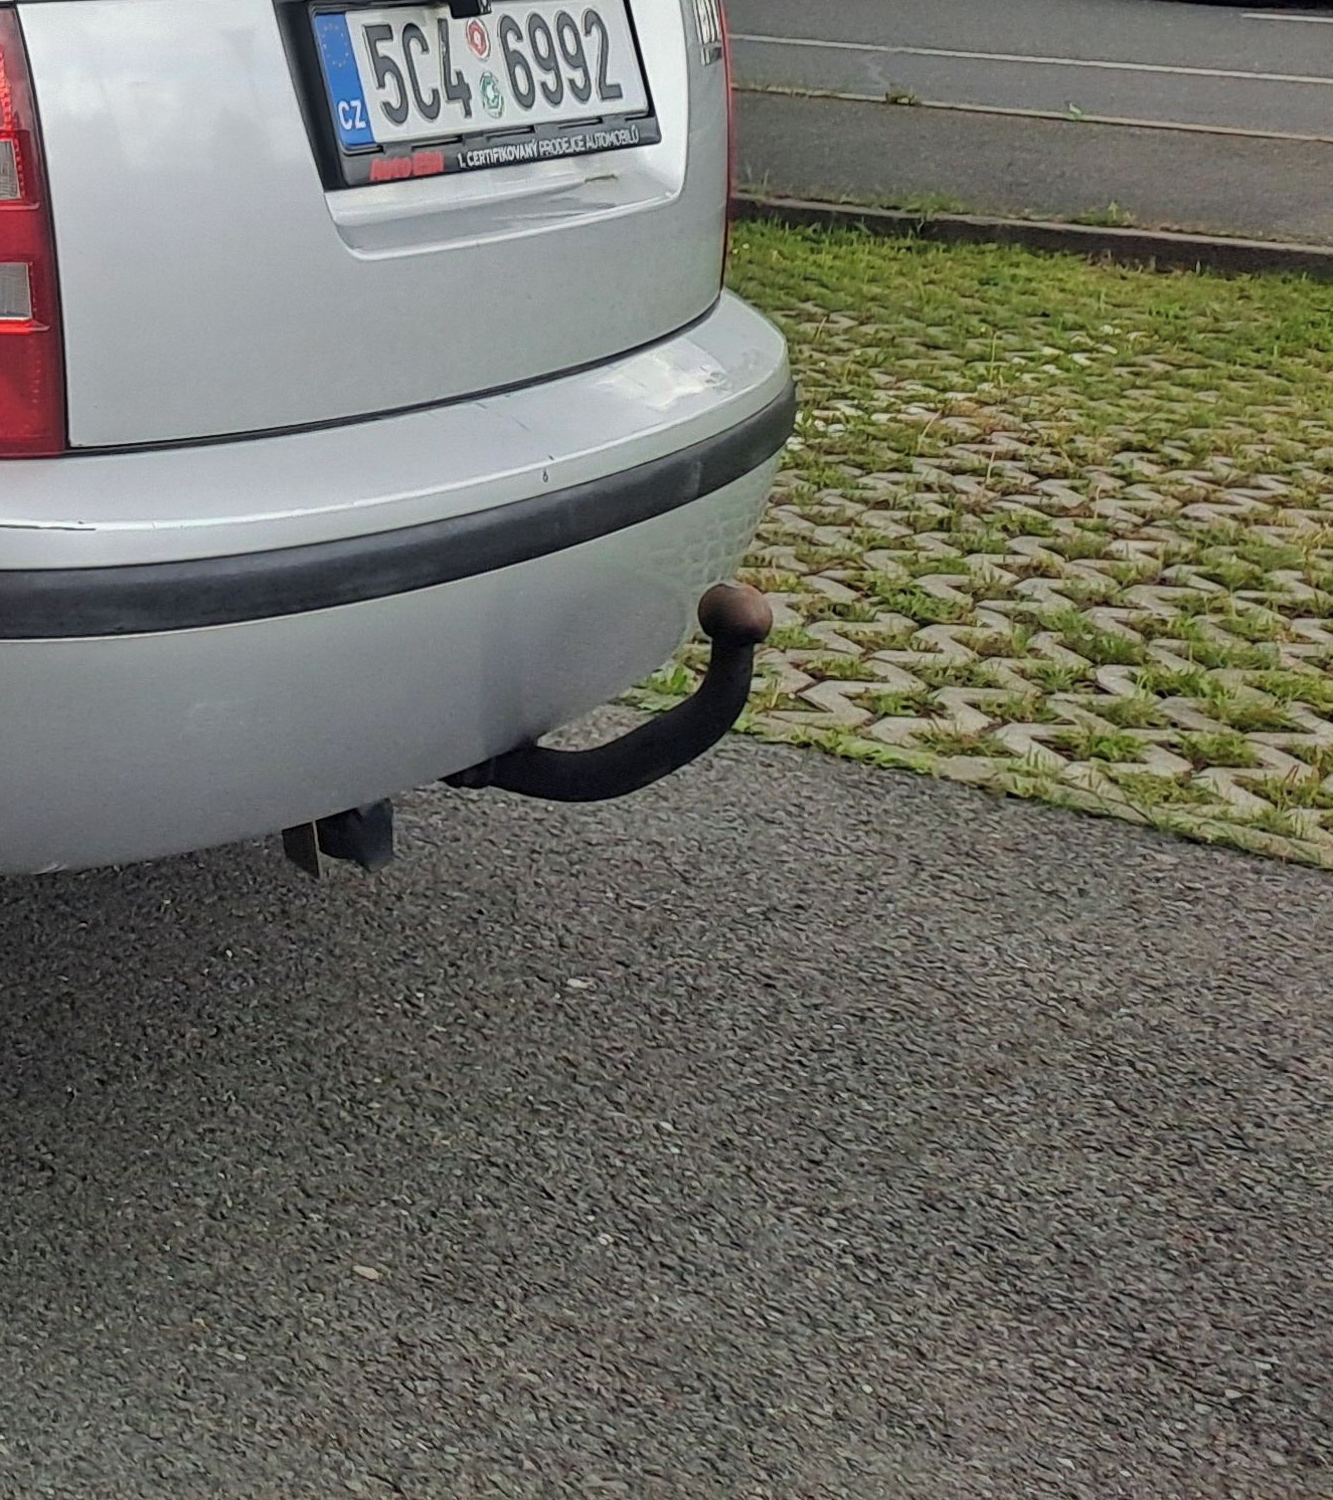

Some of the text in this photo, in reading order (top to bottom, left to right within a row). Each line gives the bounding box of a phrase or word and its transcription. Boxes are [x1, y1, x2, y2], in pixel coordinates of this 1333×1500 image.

[362, 18, 471, 126] 5C4
[497, 8, 623, 110] 6992
[338, 99, 367, 130] CZ
[539, 133, 585, 156] PRODEJCE
